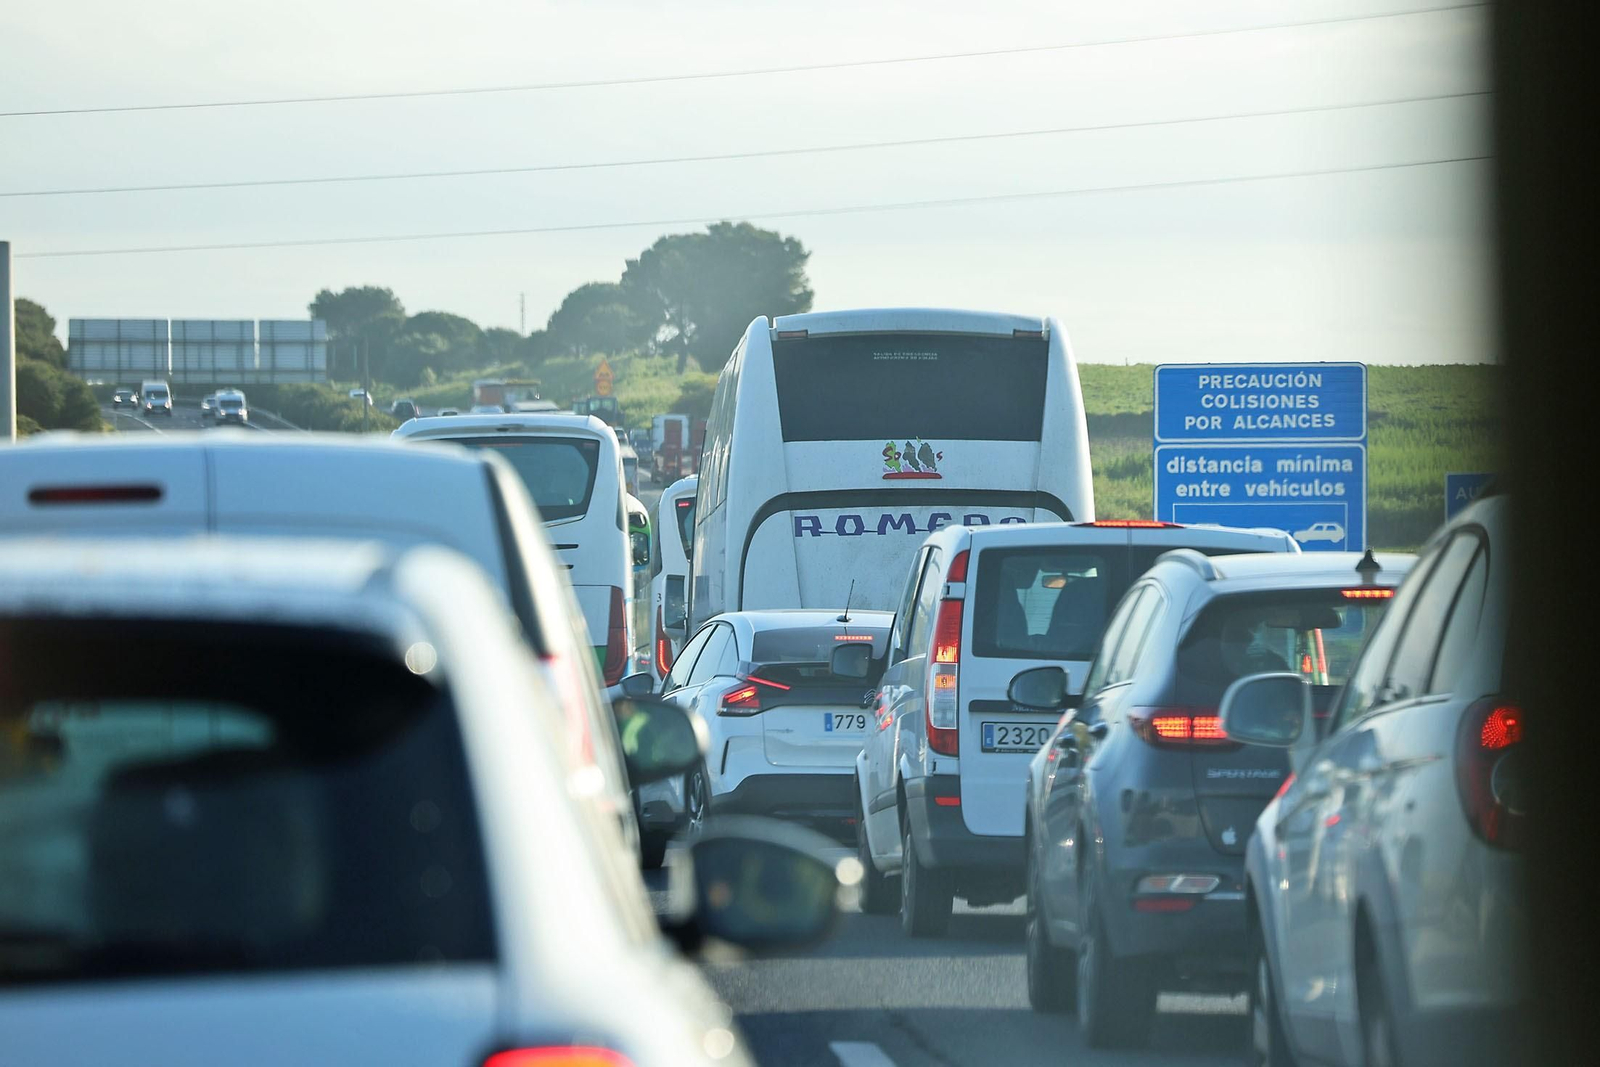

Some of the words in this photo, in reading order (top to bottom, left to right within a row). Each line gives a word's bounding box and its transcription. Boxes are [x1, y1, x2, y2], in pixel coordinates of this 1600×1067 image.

[1199, 371, 1322, 389] PRECAUCIÓN
[1201, 394, 1320, 409] COLISIONES
[1184, 415, 1222, 430] POR
[1233, 413, 1336, 430] ALCANCES
[1166, 455, 1263, 474] distancia
[1276, 454, 1353, 473] mínima
[1175, 479, 1231, 497] entre
[1244, 477, 1346, 497] vehículos
[1455, 486, 1480, 500] AU
[834, 714, 866, 730] 779
[997, 726, 1050, 746] 2320
